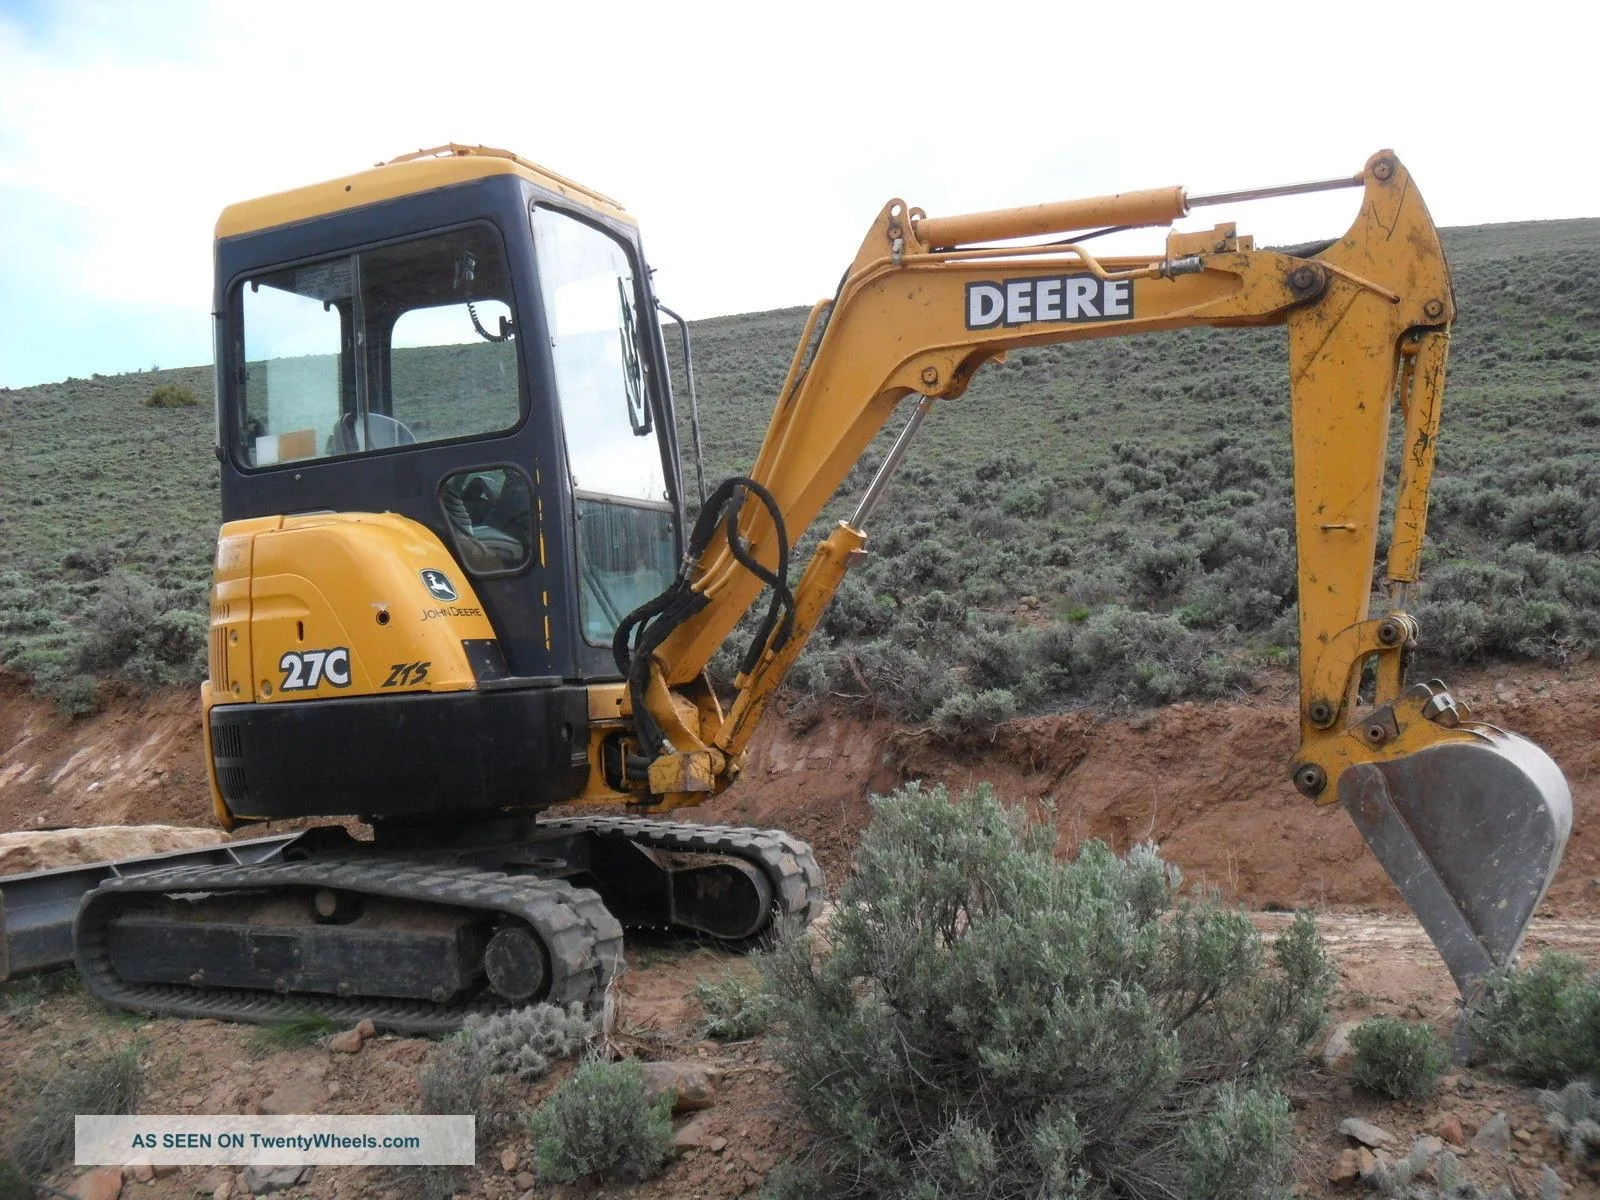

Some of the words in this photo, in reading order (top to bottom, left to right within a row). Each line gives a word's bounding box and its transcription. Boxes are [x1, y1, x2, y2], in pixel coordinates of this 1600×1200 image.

[968, 276, 1131, 327] DEERE
[280, 649, 349, 689] 27C
[381, 661, 431, 688] ZTS
